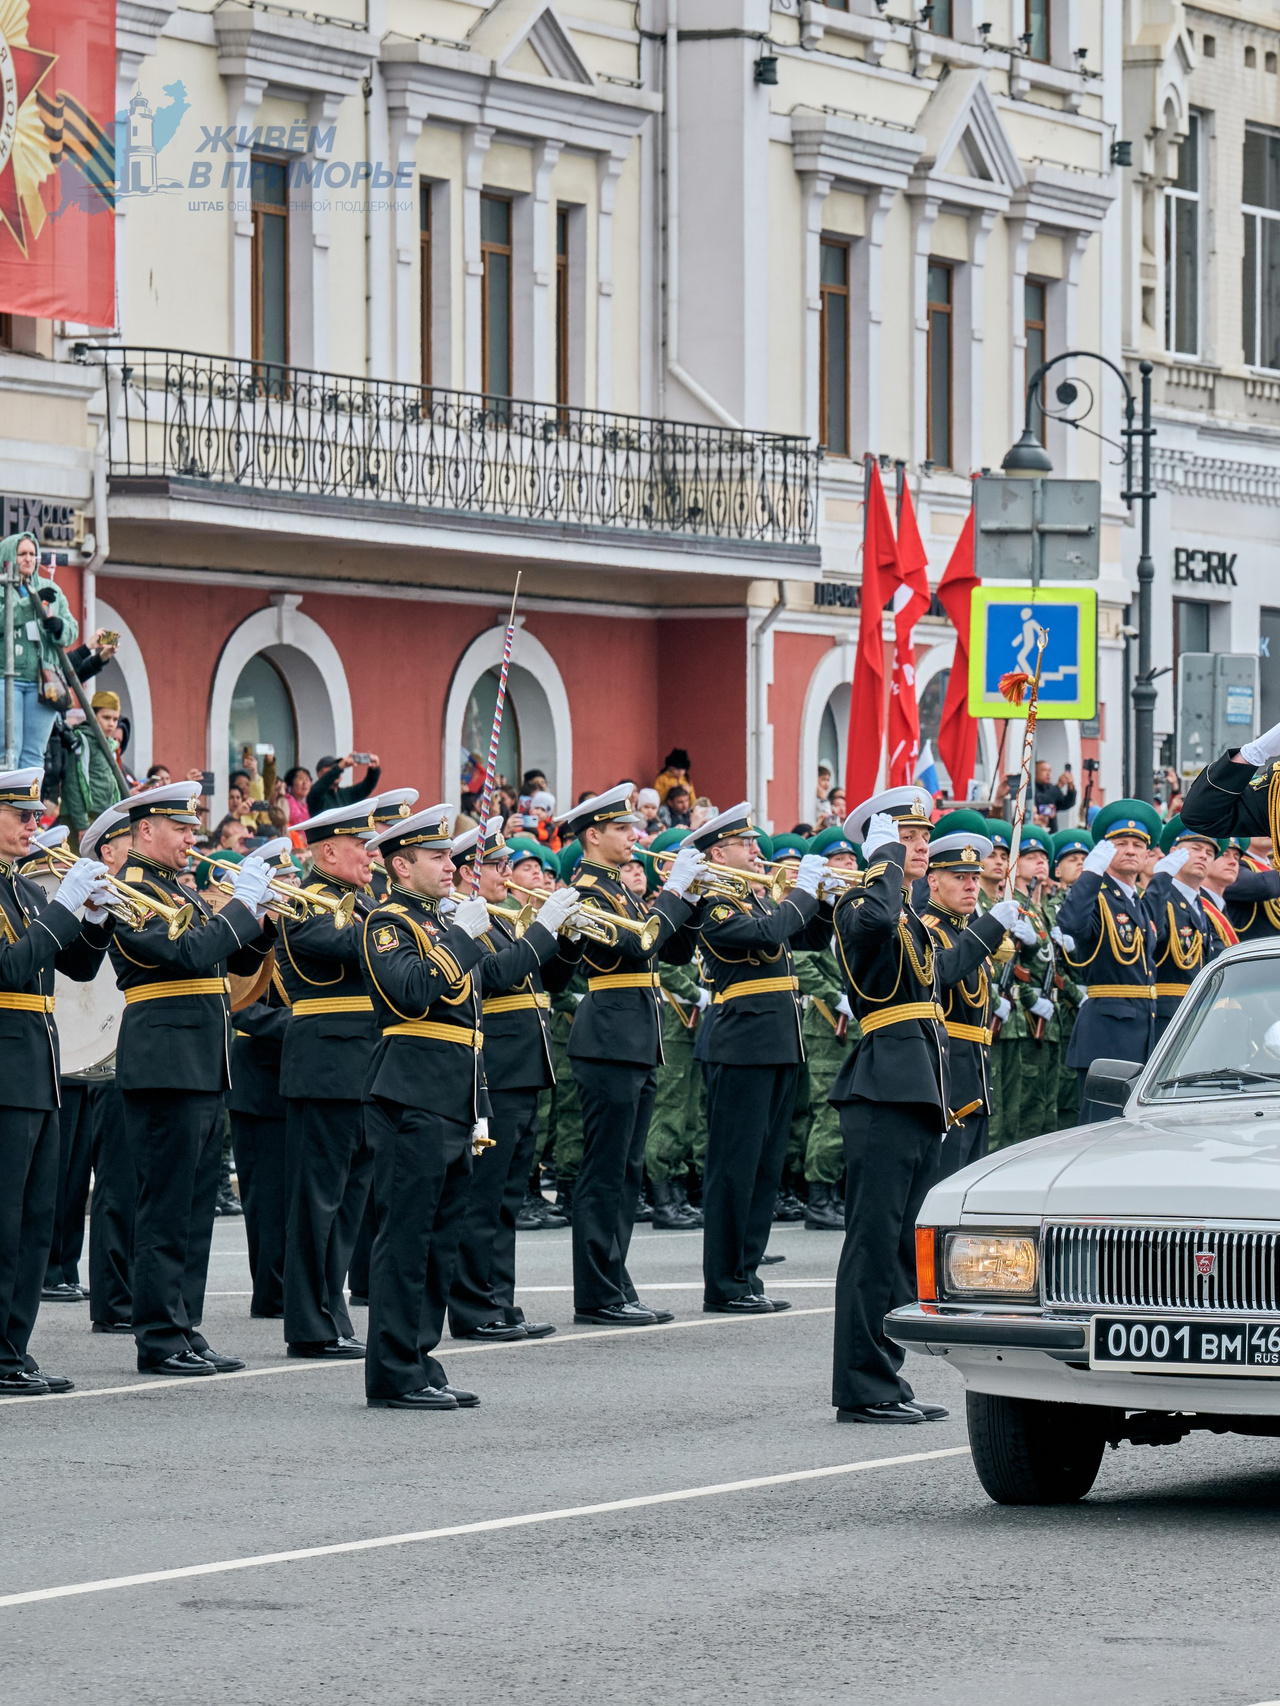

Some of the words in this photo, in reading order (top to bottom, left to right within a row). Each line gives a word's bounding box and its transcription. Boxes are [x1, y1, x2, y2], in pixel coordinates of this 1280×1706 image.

[1174, 547, 1238, 587] BORK
[1108, 1323, 1191, 1359] 0001
[1201, 1333, 1242, 1361] ВМ
[1254, 1353, 1279, 1364] RUS
